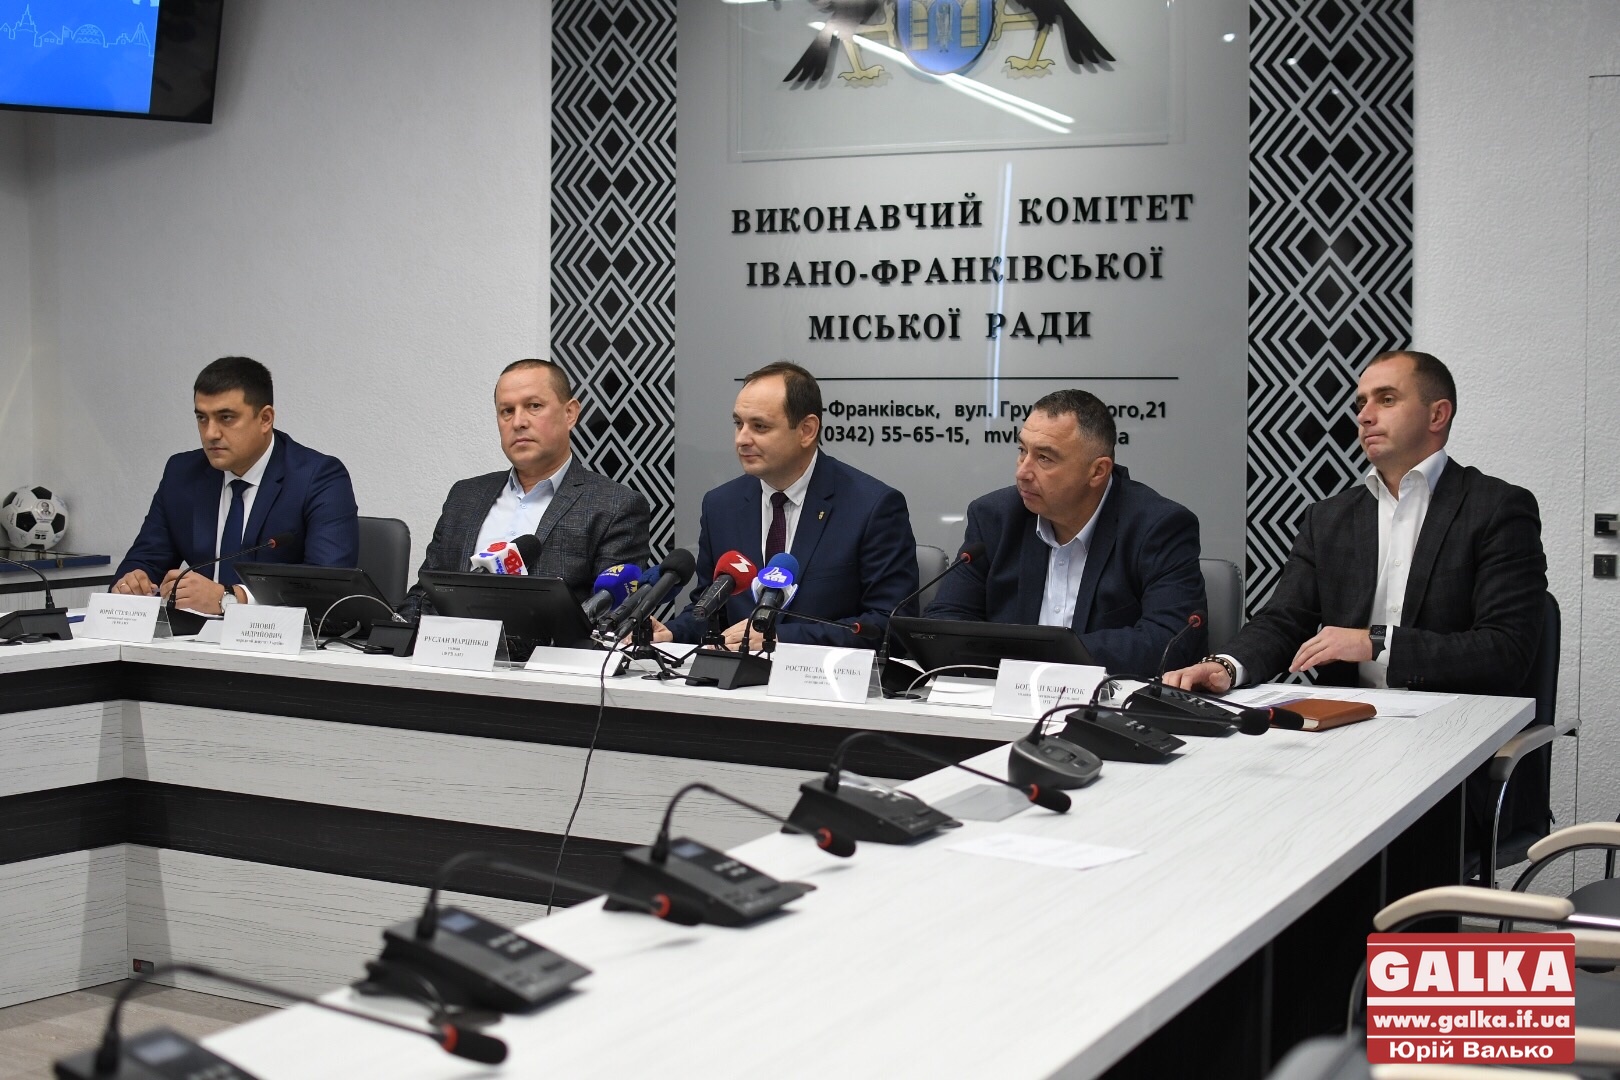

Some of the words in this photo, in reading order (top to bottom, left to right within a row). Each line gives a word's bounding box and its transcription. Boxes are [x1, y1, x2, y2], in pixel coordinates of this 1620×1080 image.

[731, 192, 983, 234] ВИКОНАВЧИЙ
[1019, 193, 1195, 226] КОМІТЕТ
[746, 246, 1164, 287] ІВАНО-ФРАНКІВСЬКОЇ
[808, 307, 961, 341] МІСЬКОЇ
[986, 311, 1092, 344] РАДИ
[822, 400, 940, 420] -Франківськ,
[954, 404, 993, 421] вул.
[881, 426, 970, 445] 55-65-15,
[785, 664, 824, 674] РОСТИСЛА
